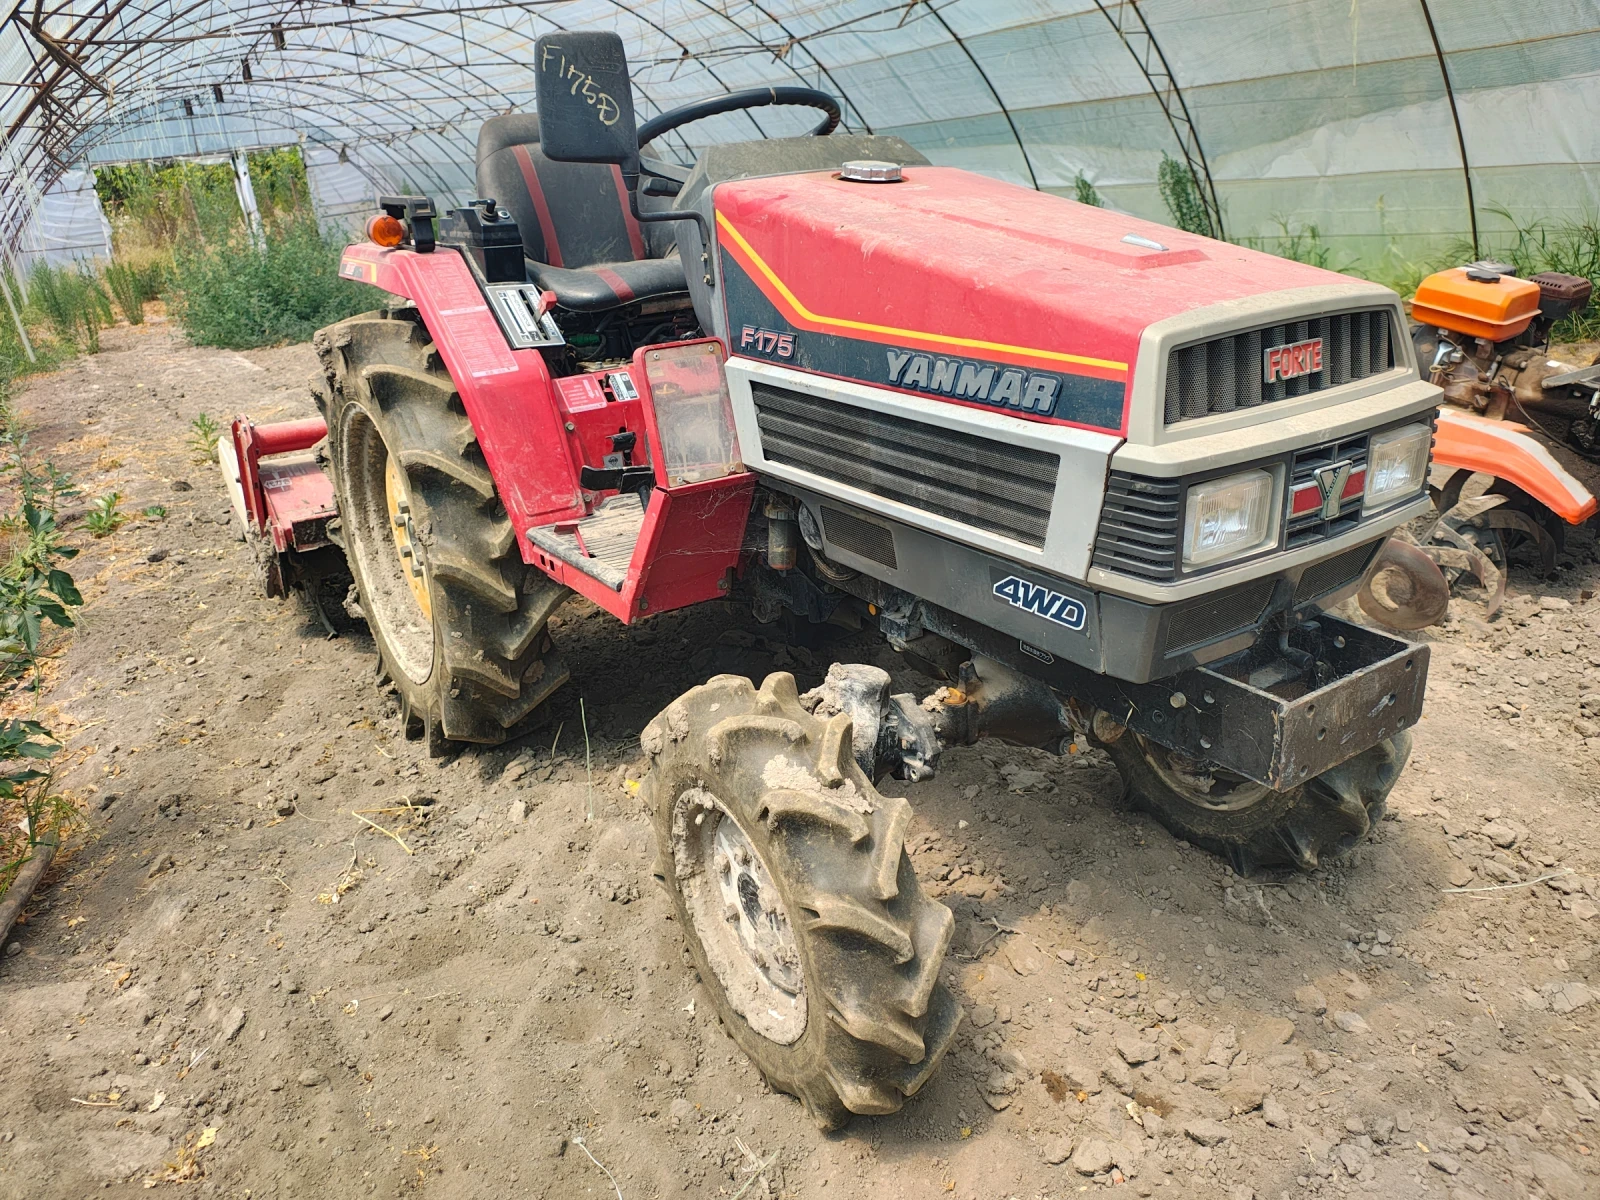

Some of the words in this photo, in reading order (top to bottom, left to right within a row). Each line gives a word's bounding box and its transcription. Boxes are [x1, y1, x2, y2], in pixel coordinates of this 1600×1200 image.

[741, 326, 793, 357] F175
[1268, 338, 1323, 381] FORTE
[886, 350, 1058, 413] YANMAR
[993, 575, 1087, 631] 4WD
